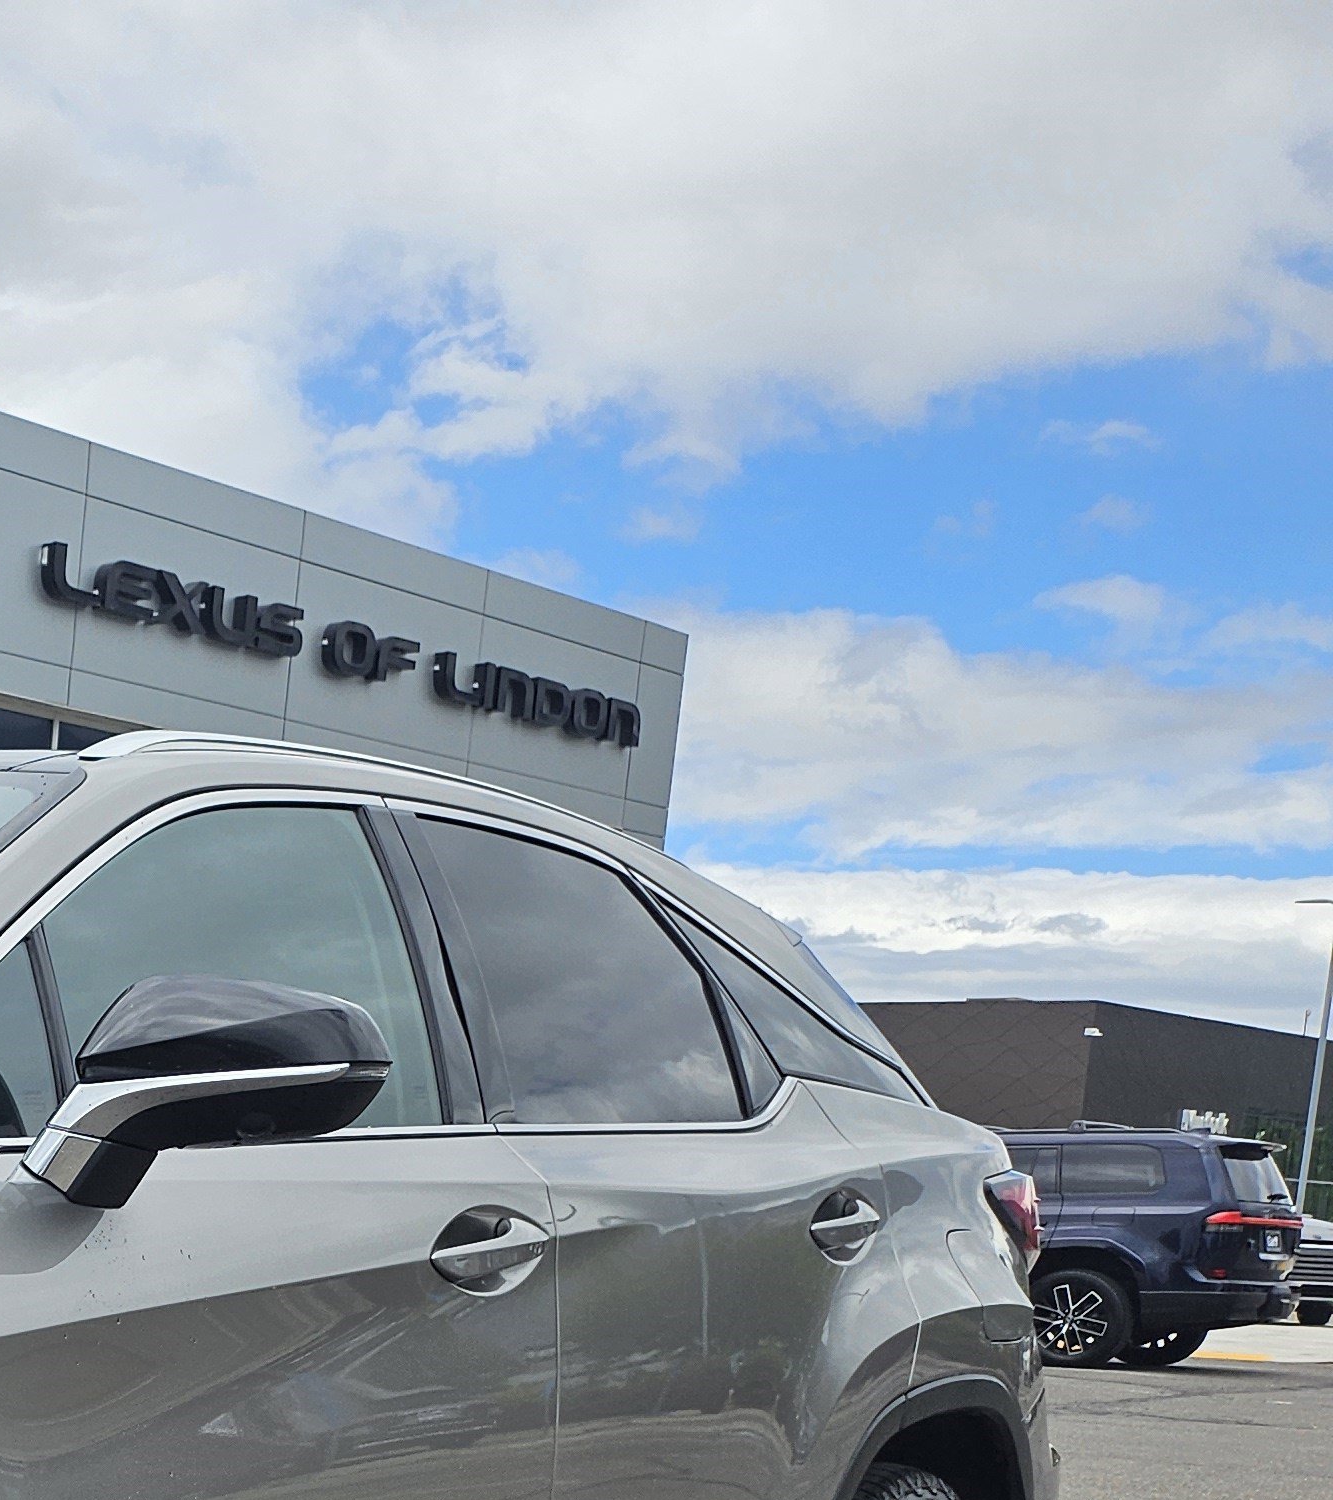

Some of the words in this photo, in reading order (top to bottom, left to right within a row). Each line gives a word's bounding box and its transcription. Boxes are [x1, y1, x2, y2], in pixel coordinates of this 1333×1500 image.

[40, 541, 304, 658] LEXUS
[320, 620, 421, 682] OF
[432, 651, 641, 748] LINDON
